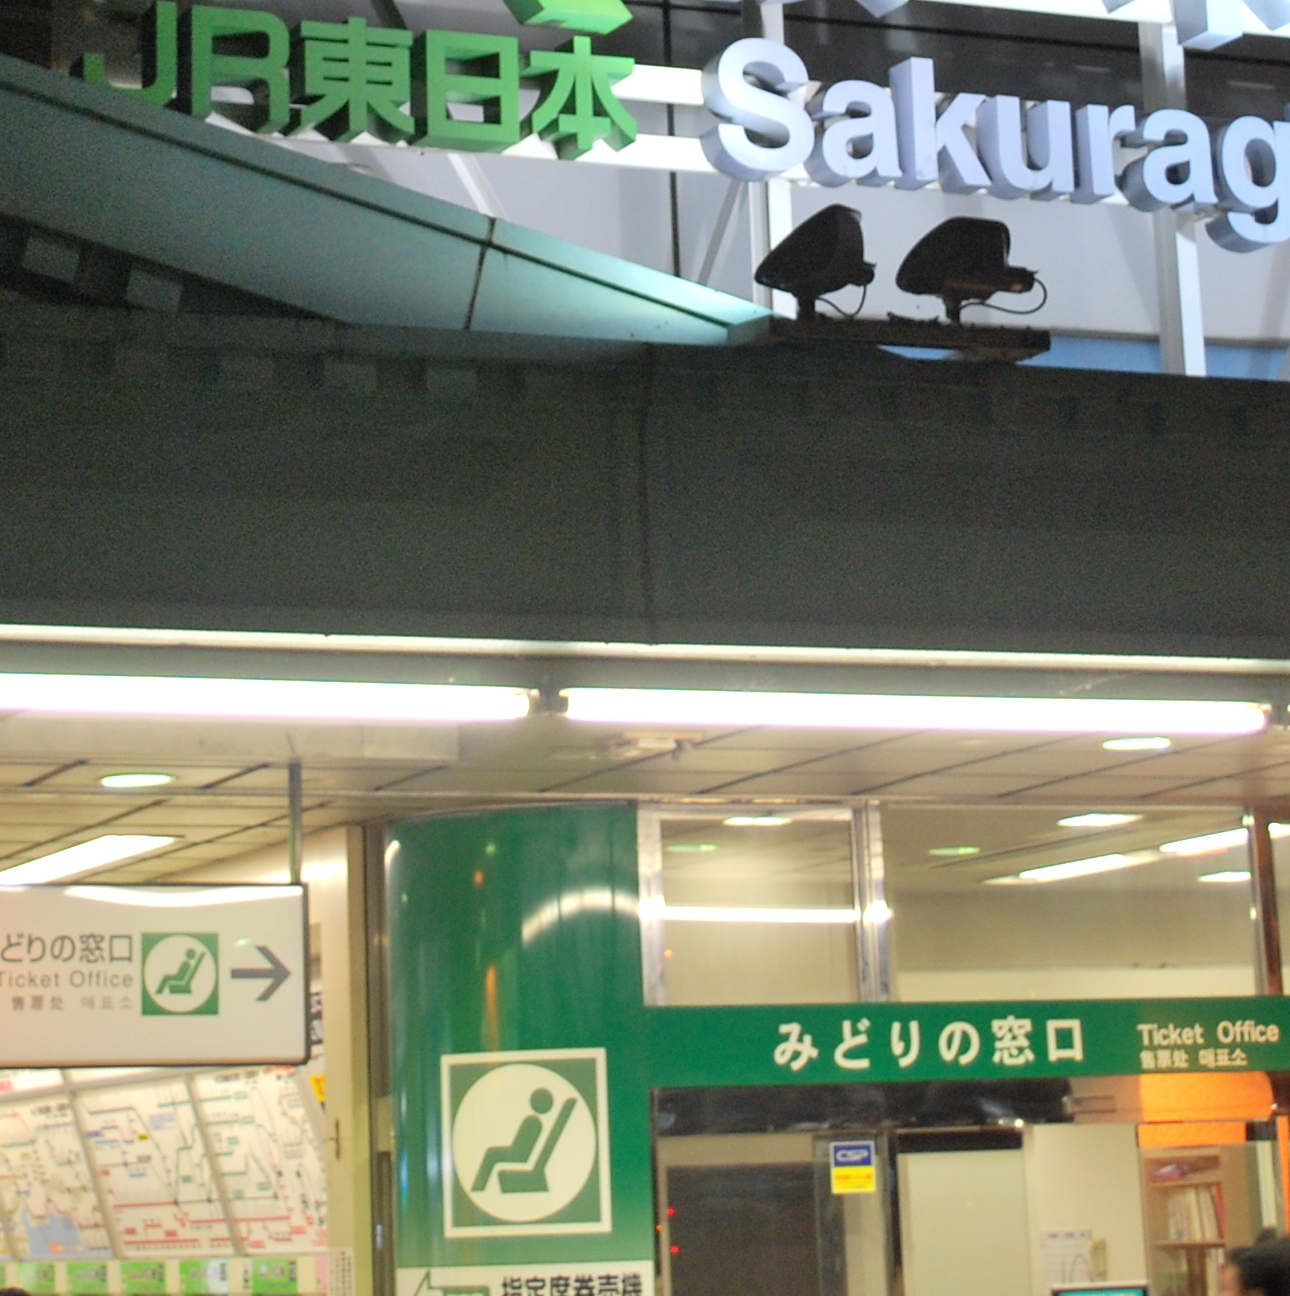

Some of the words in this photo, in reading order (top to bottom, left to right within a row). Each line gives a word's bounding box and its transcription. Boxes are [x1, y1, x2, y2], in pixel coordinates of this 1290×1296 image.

[83, 0, 638, 160] JR東日本
[69, 970, 134, 988] Office
[774, 1015, 1084, 1071] みどりの窓口
[1137, 1023, 1205, 1046] Ticket
[1217, 1019, 1280, 1044] Office
